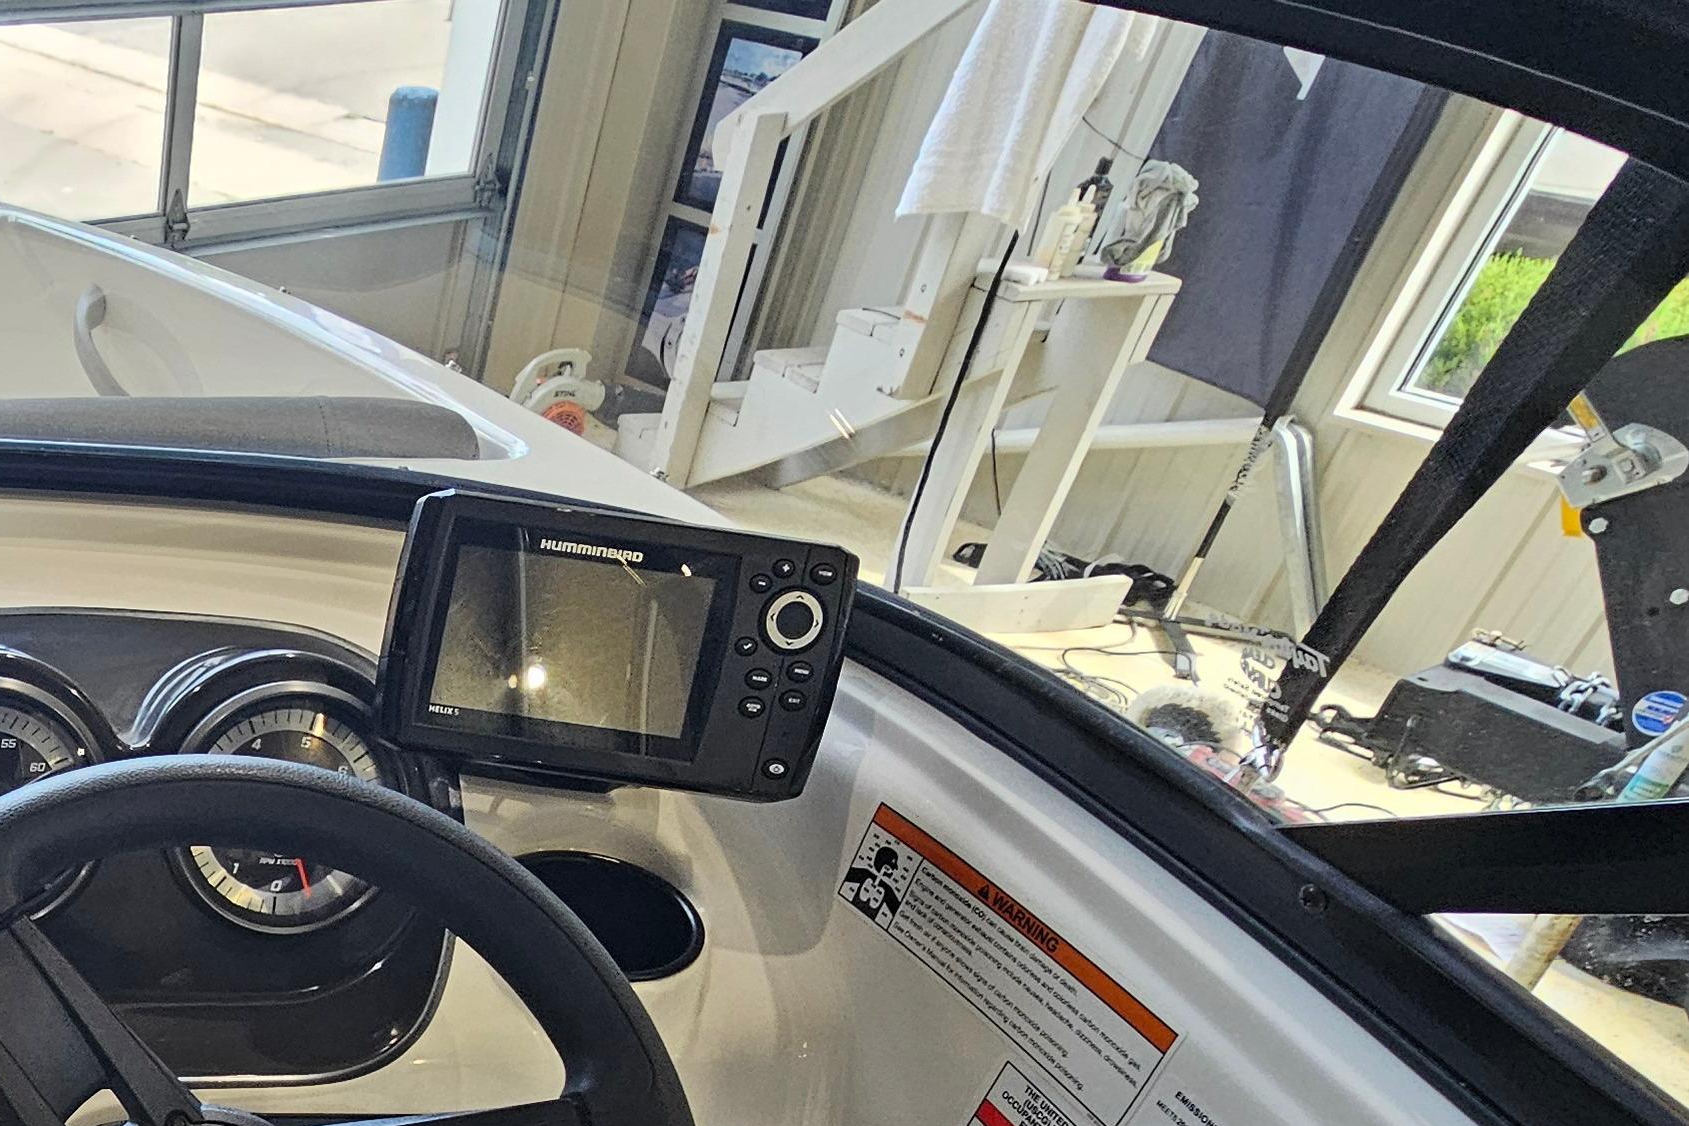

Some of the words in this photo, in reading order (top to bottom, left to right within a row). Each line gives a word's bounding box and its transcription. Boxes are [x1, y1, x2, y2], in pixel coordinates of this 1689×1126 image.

[540, 538, 644, 563] HUMMINBIRD
[428, 704, 453, 715] HELIX
[0, 738, 17, 749] 55
[251, 738, 262, 750] 4
[300, 736, 312, 749] 5
[29, 762, 46, 773] 60
[232, 862, 240, 874] 1
[270, 880, 283, 892] 0
[992, 891, 1059, 953] WARNING
[1024, 1084, 1041, 1104] THE
